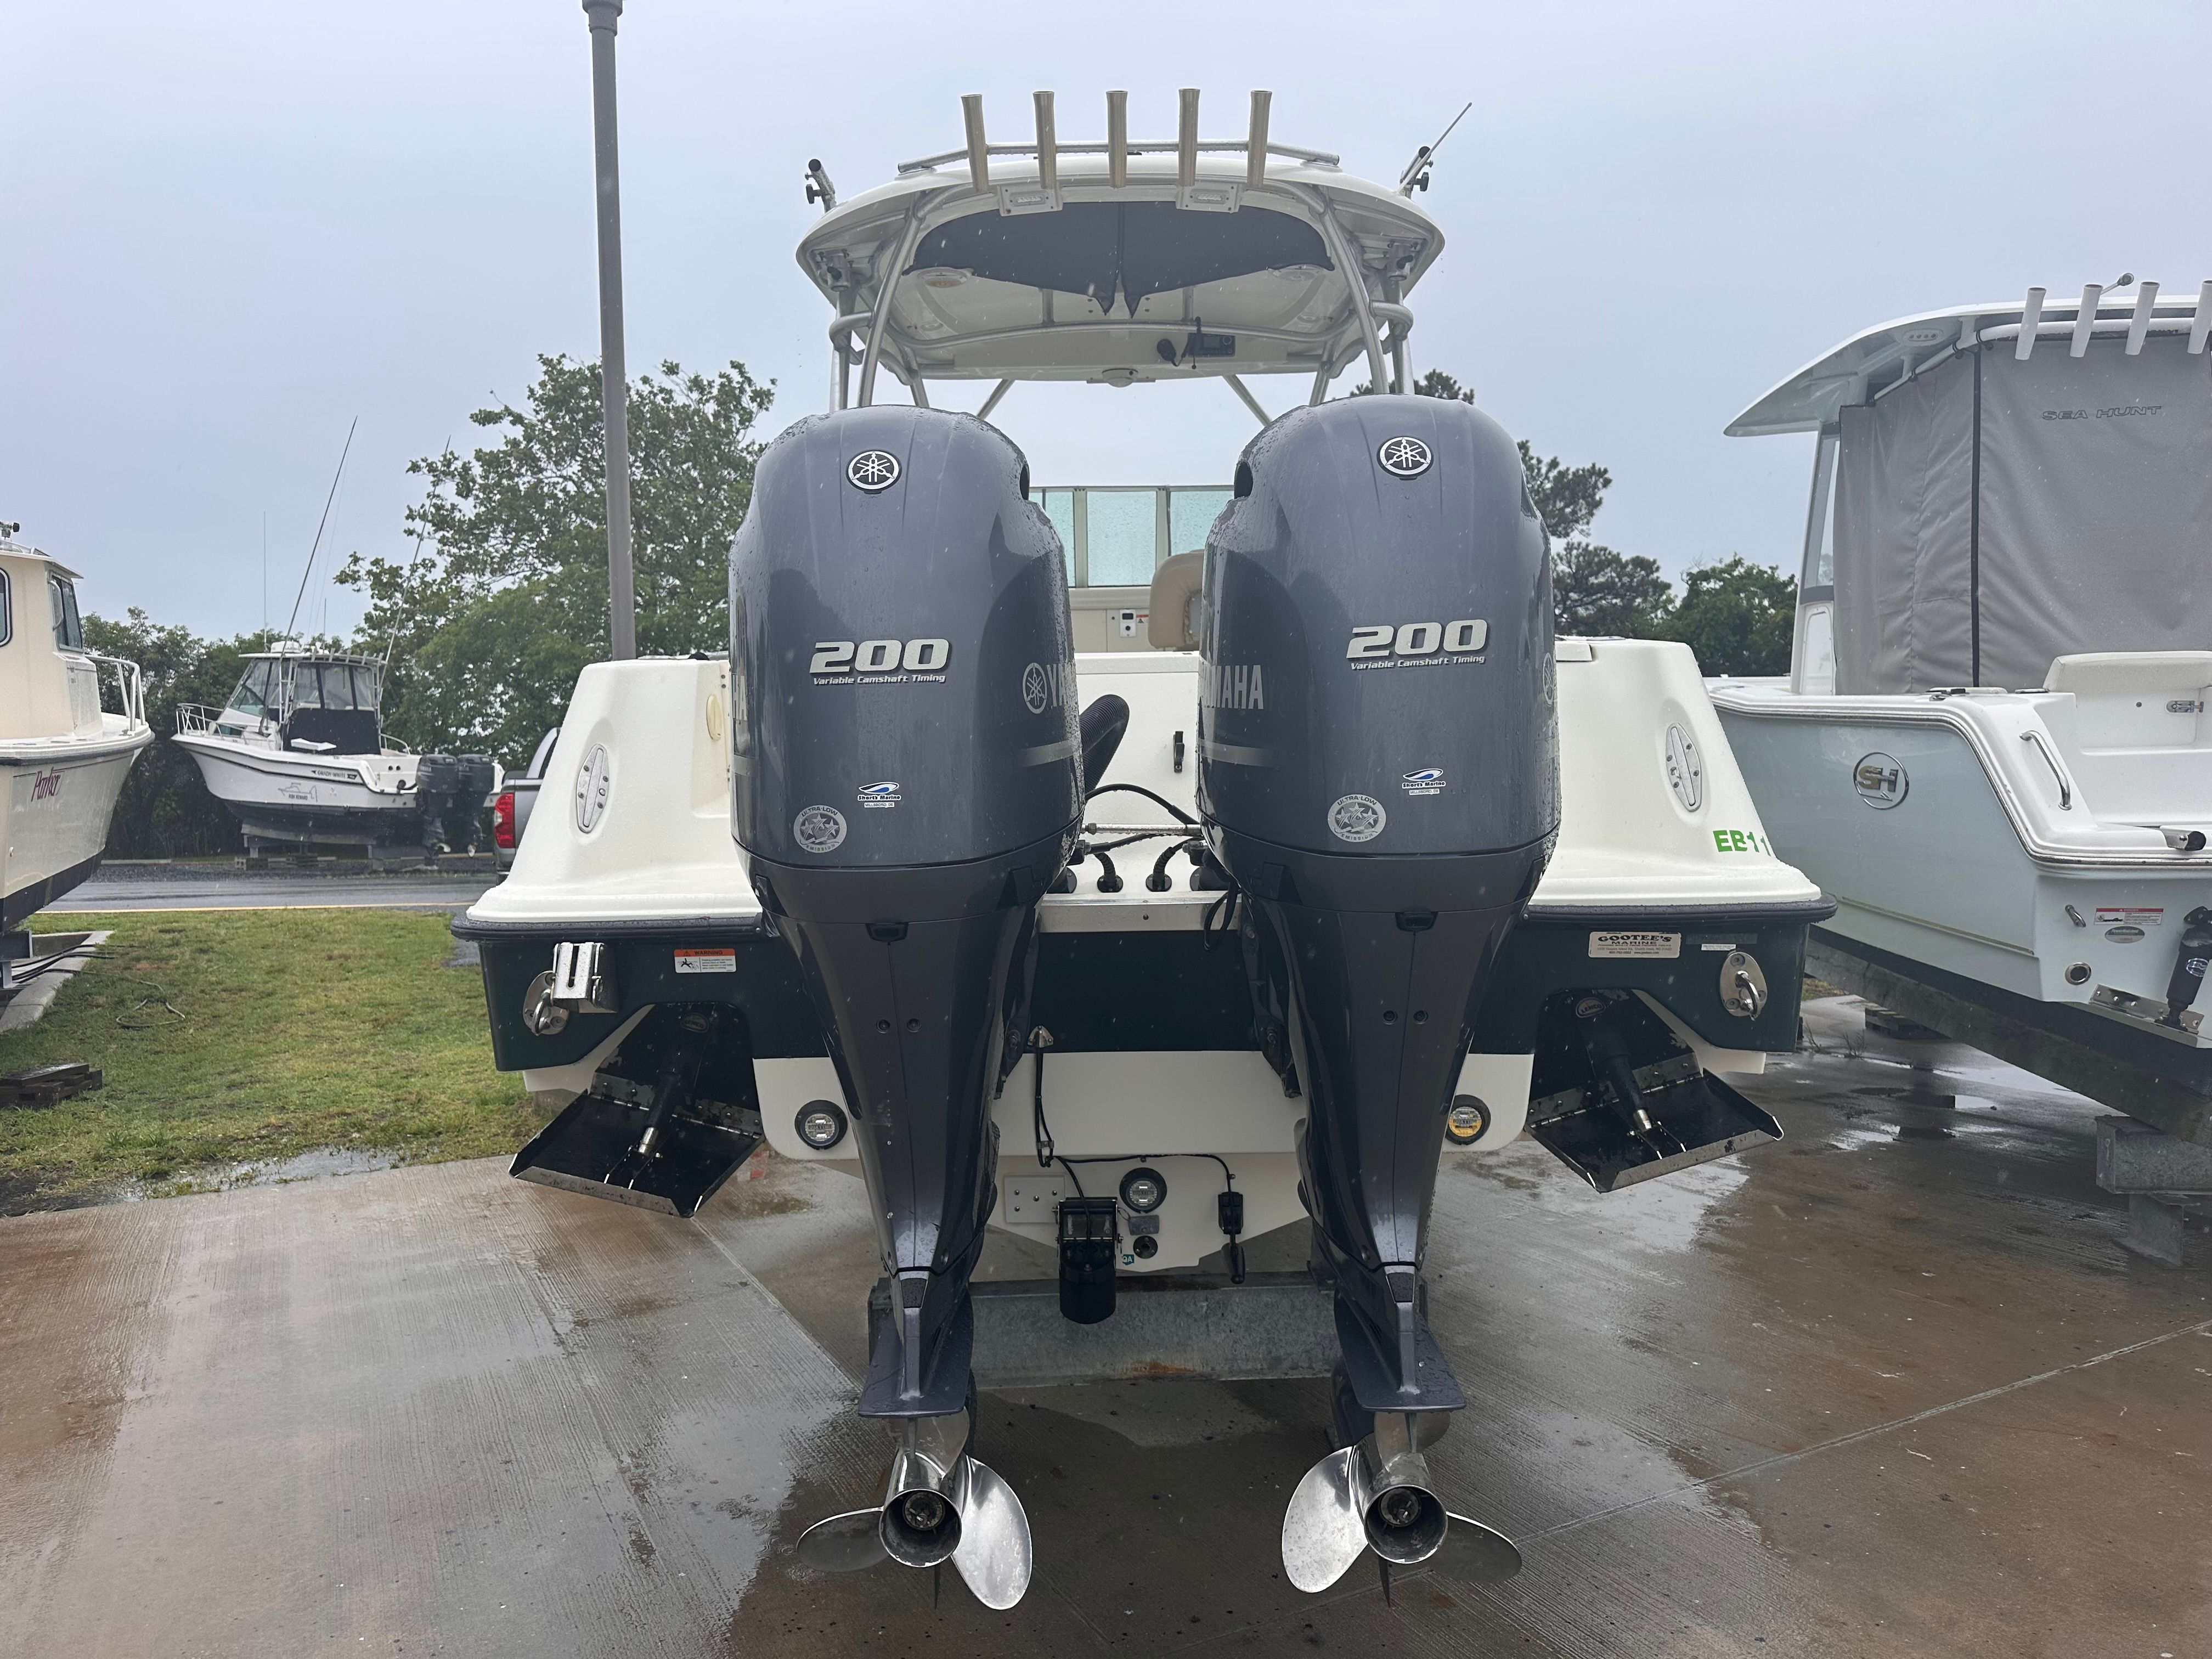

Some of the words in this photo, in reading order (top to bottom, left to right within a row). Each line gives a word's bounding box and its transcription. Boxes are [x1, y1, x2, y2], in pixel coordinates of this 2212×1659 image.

[2042, 410, 2089, 421] SEA
[2096, 406, 2162, 419] HUNT
[1346, 619, 1488, 659] 200
[809, 639, 950, 674] 200
[1351, 661, 1395, 670] Variable
[1397, 657, 1449, 667] Camshaft
[814, 676, 854, 685] Variable
[857, 675, 909, 684] Camshaft
[912, 674, 946, 682] Timing
[1201, 664, 1264, 709] AMAHA
[31, 766, 61, 802] Parker
[1581, 1004, 1602, 1013] LENCO
